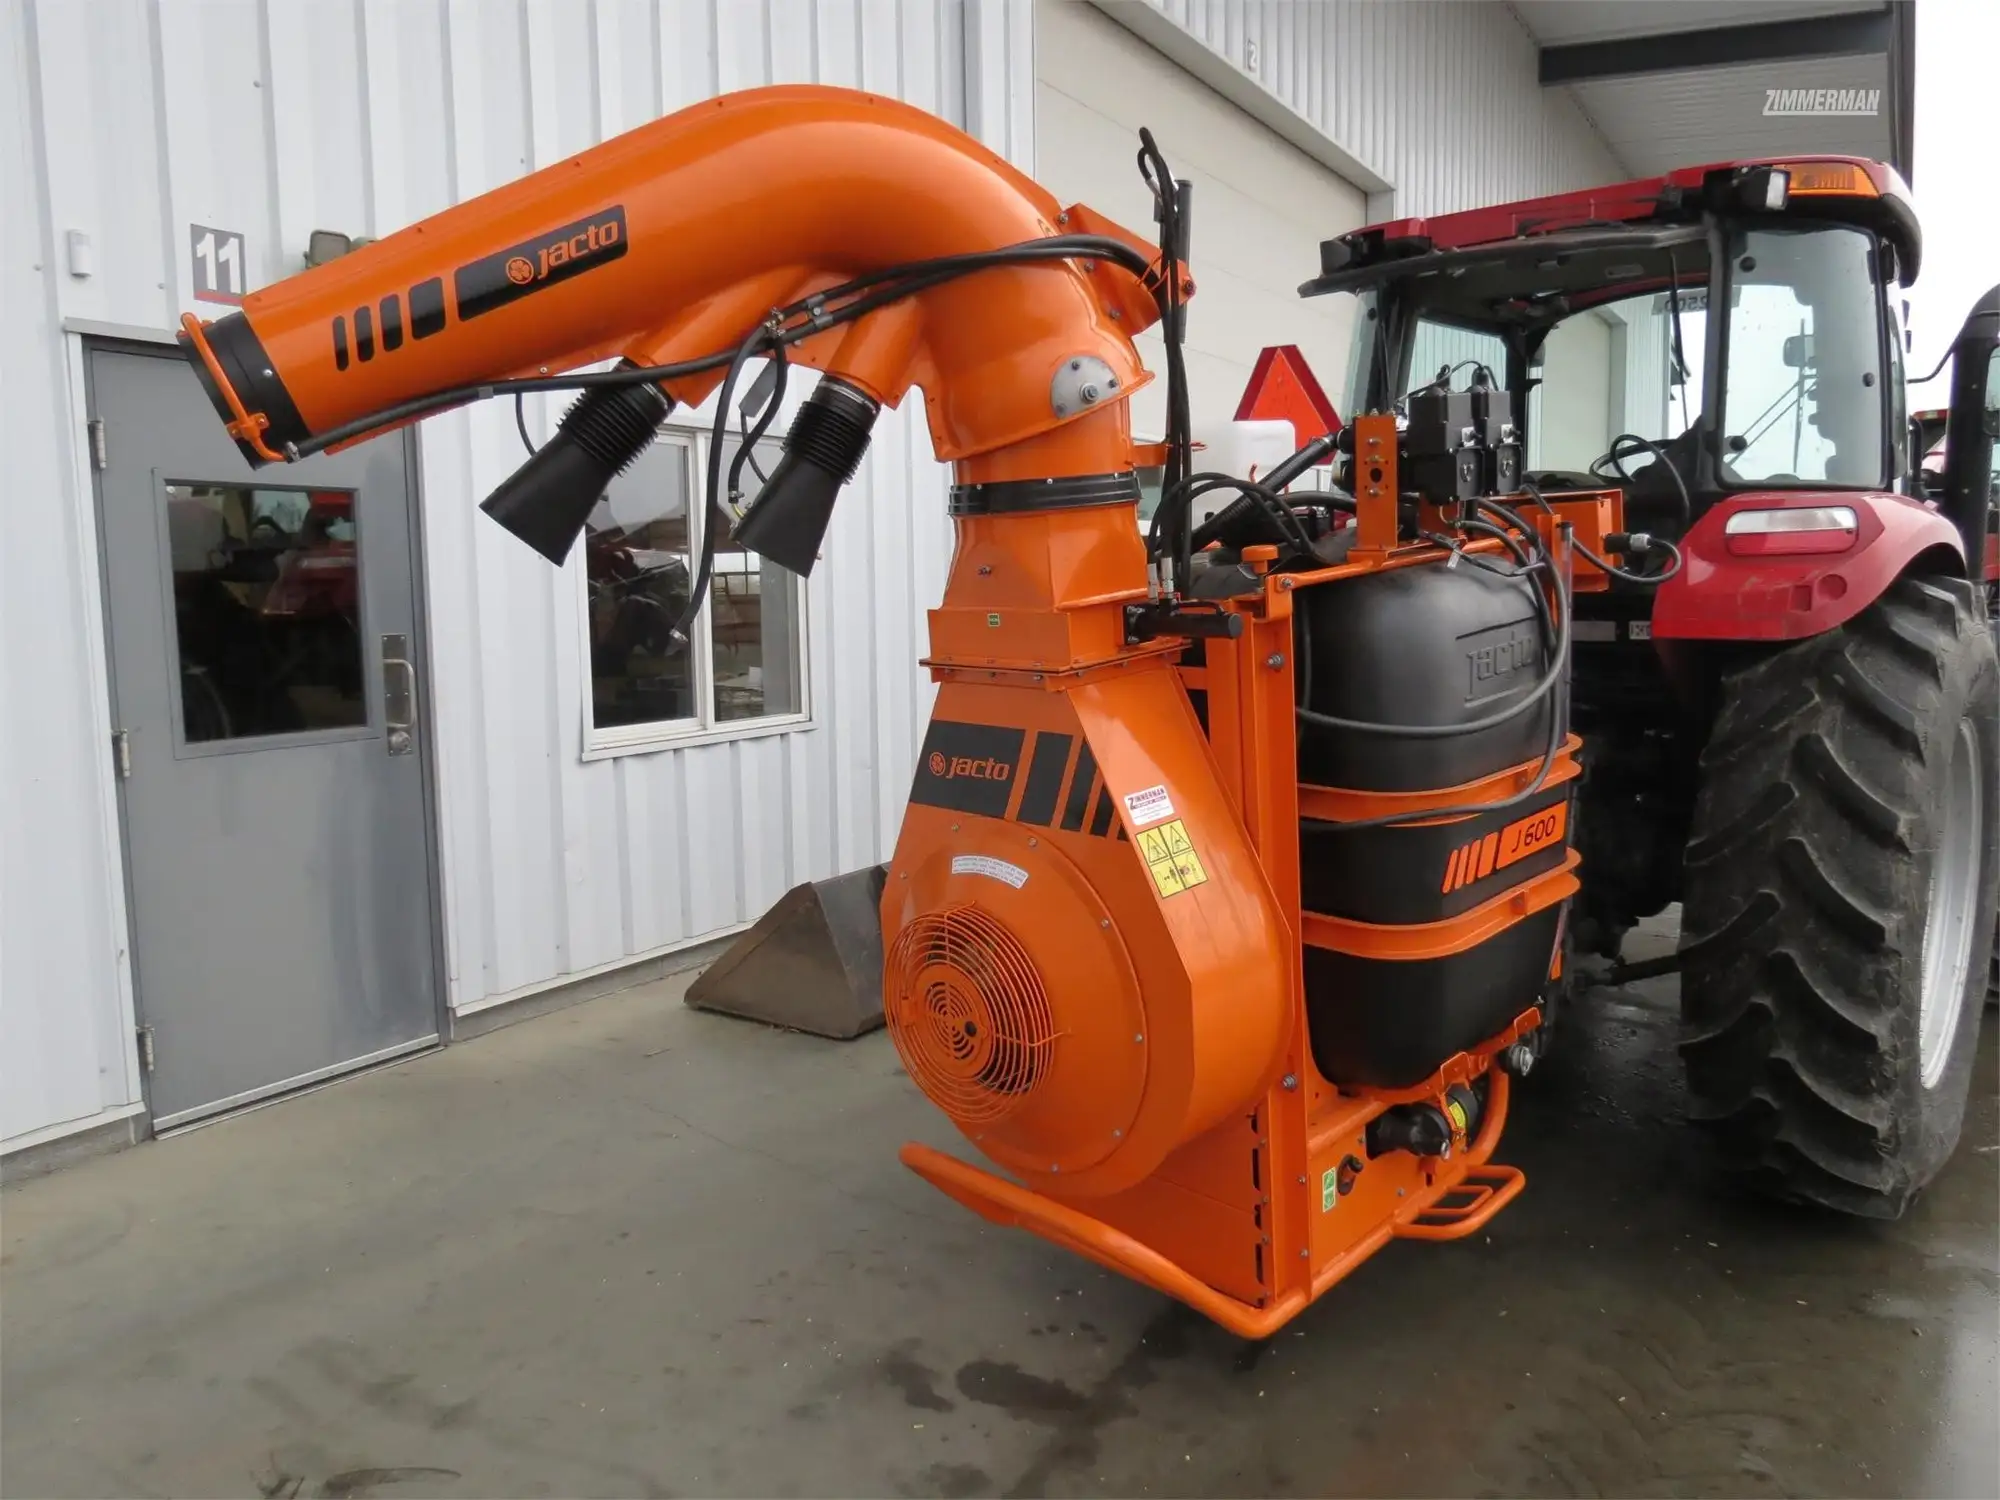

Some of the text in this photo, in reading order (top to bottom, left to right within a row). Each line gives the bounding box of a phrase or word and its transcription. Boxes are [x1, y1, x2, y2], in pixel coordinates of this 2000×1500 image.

[196, 232, 242, 294] 11
[538, 221, 618, 280] jacto
[945, 756, 1010, 780] jacto
